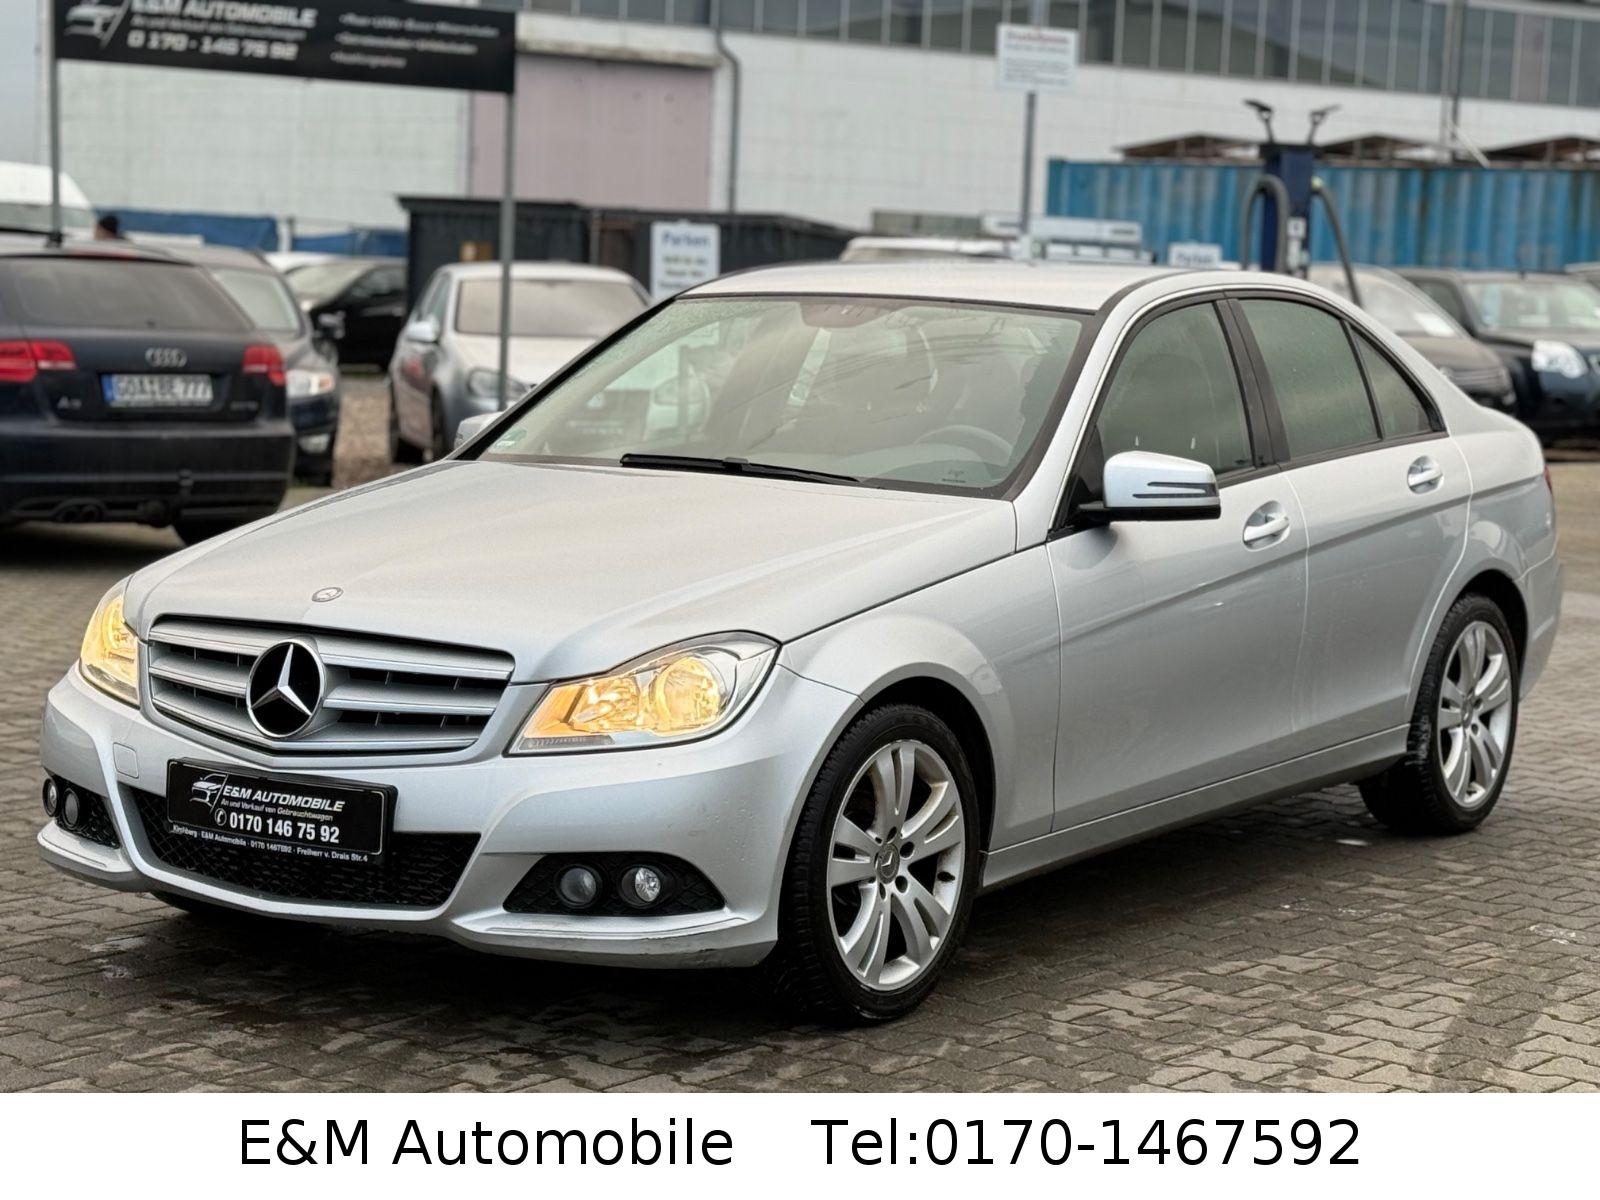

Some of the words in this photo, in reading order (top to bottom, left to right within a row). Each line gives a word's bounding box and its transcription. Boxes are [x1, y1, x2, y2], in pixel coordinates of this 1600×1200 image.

[182, 0, 319, 29] AUTOMOBILE
[220, 798, 229, 806] An
[229, 800, 241, 808] und
[241, 801, 265, 811] Verkauf
[277, 807, 334, 821] Gebrauchtwagen
[222, 785, 253, 800] E&M
[252, 790, 346, 812] AUTOMOBILE
[229, 812, 262, 833] 0170
[266, 817, 293, 837] 146
[297, 822, 316, 840] 75
[320, 825, 340, 844] 92
[214, 833, 246, 846] Automobile
[250, 840, 265, 850] 0170
[296, 847, 323, 857] Freiherr
[331, 851, 350, 860] Drais
